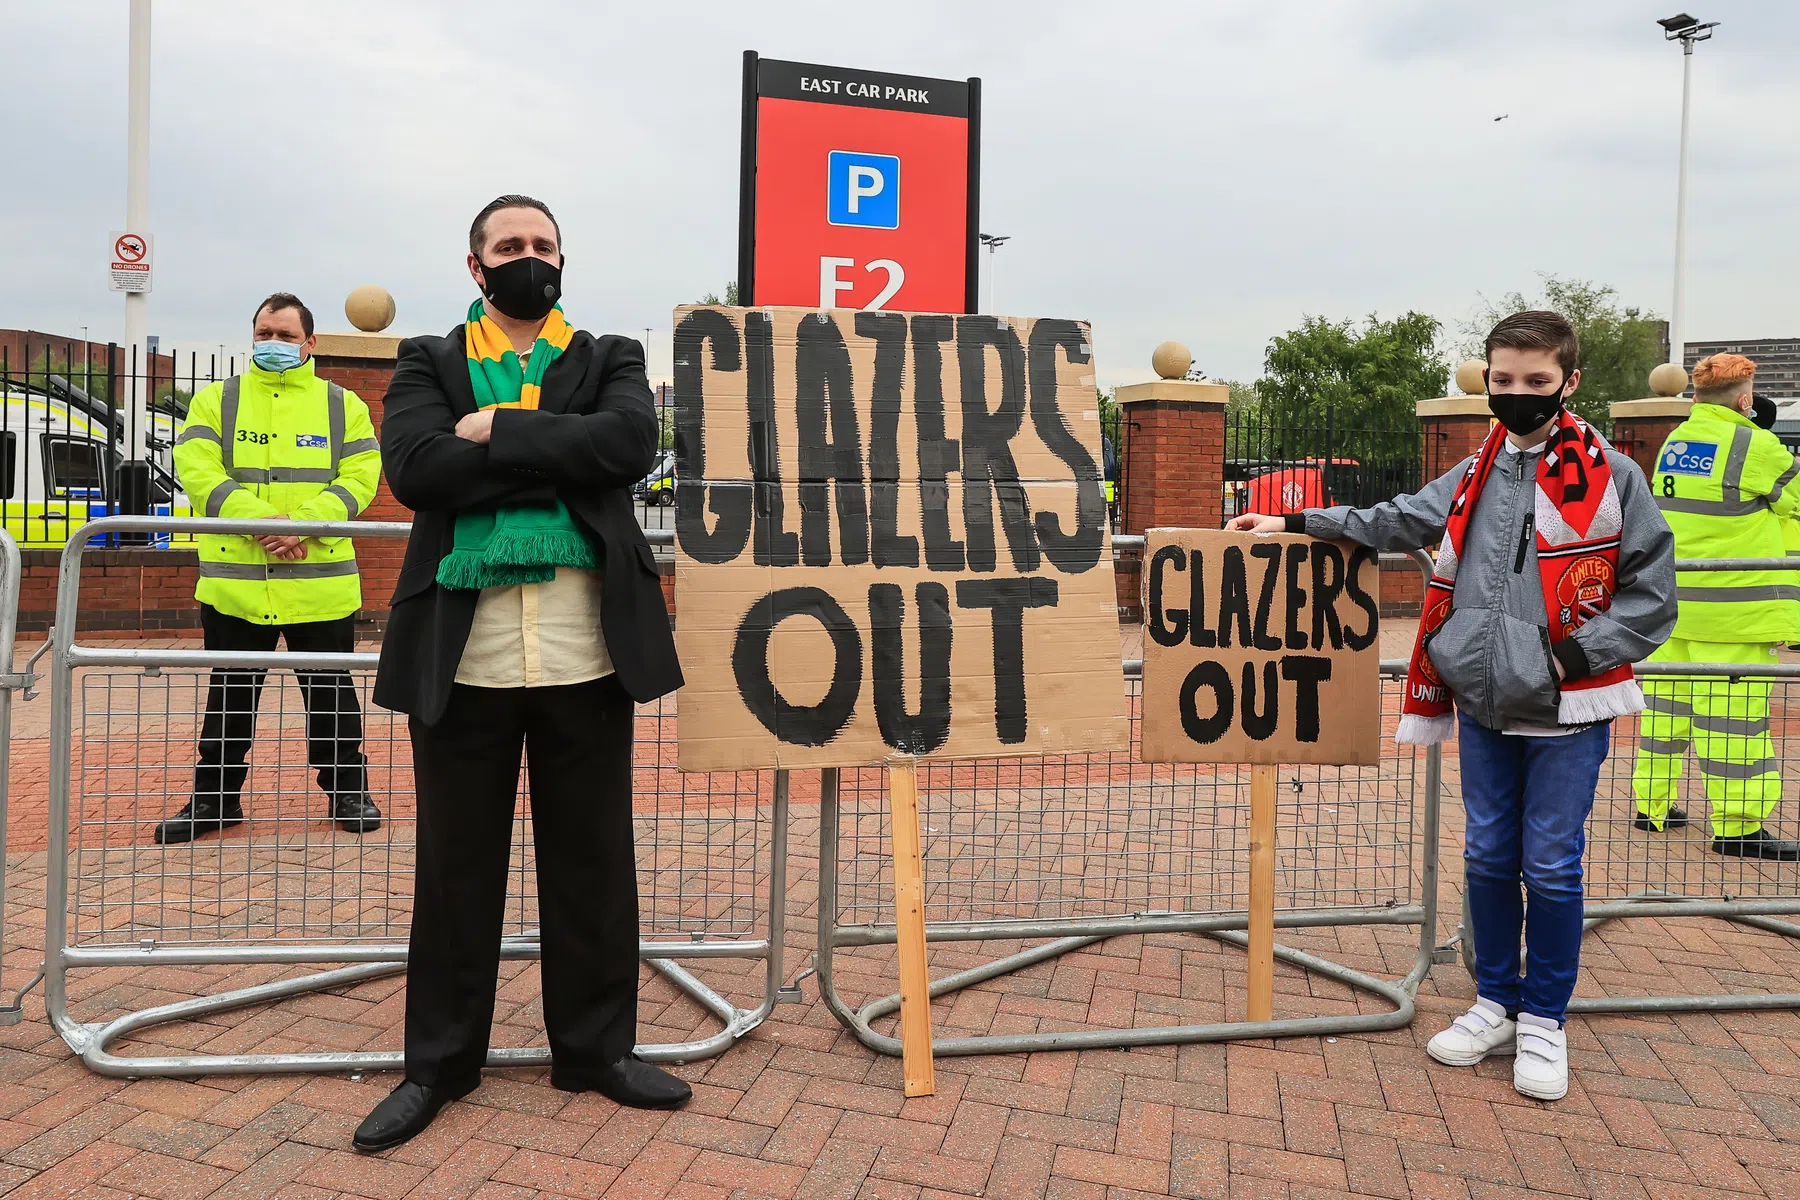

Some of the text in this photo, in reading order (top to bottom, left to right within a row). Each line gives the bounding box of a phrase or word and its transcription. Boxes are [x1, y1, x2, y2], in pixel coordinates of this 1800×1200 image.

[800, 77, 930, 104] EAST CAR PARK
[848, 164, 885, 214] P
[236, 429, 269, 445] 338
[309, 440, 328, 449] CSG
[673, 308, 1107, 575] GLAZERS
[1679, 454, 1713, 471] CSG
[1570, 560, 1609, 587] UNITED
[1148, 541, 1379, 652] GLAZERS
[731, 576, 1059, 755] OUT
[1178, 655, 1332, 745] OUT
